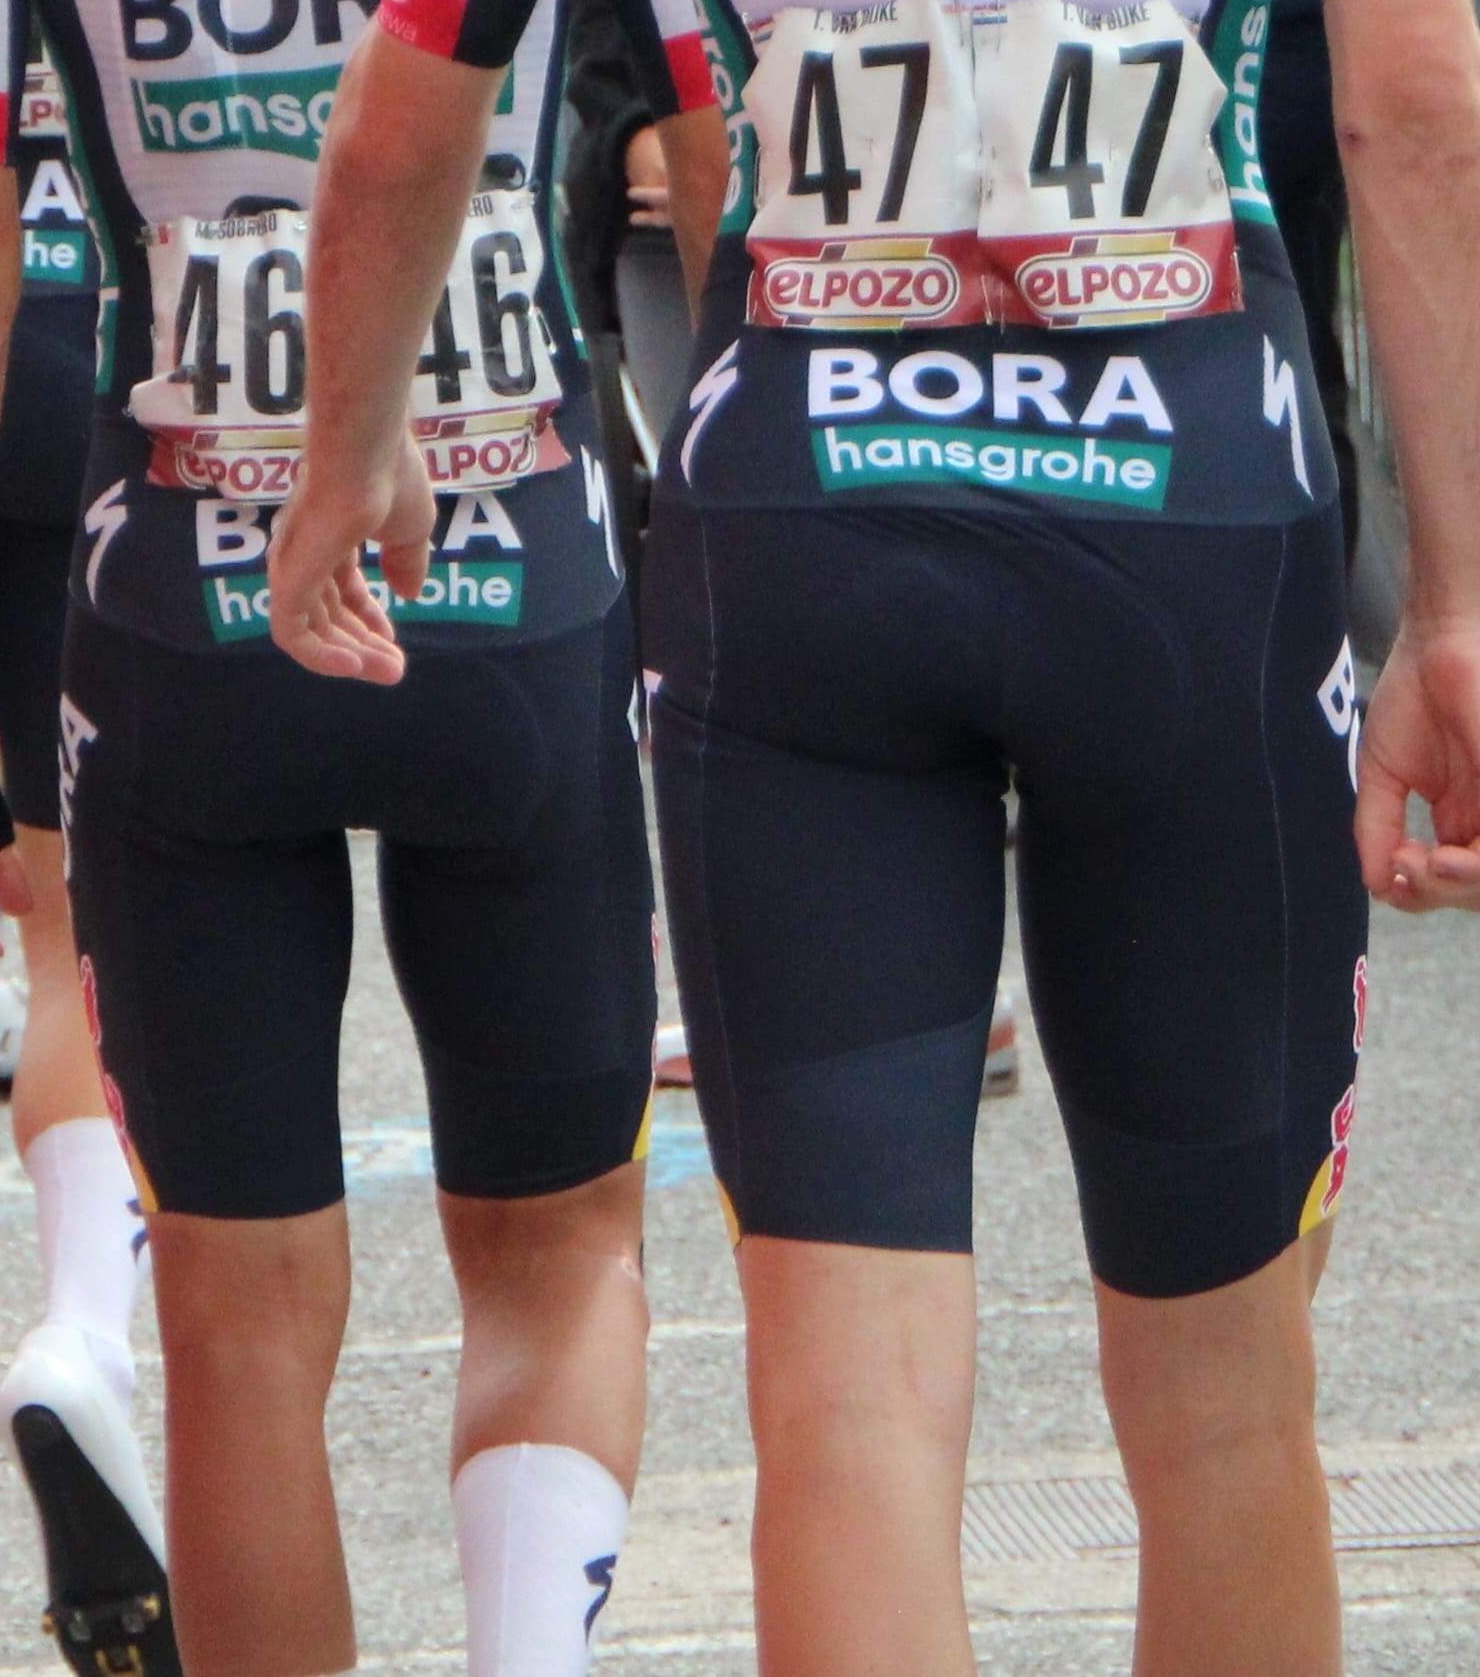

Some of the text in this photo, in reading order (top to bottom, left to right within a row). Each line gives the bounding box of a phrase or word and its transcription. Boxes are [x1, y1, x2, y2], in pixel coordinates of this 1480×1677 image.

[788, 41, 930, 226] 47
[1028, 38, 1185, 221] 47
[173, 247, 306, 417] 46
[417, 230, 537, 404] 46
[808, 347, 1173, 434] BORA
[824, 427, 1157, 491] hansgrohe
